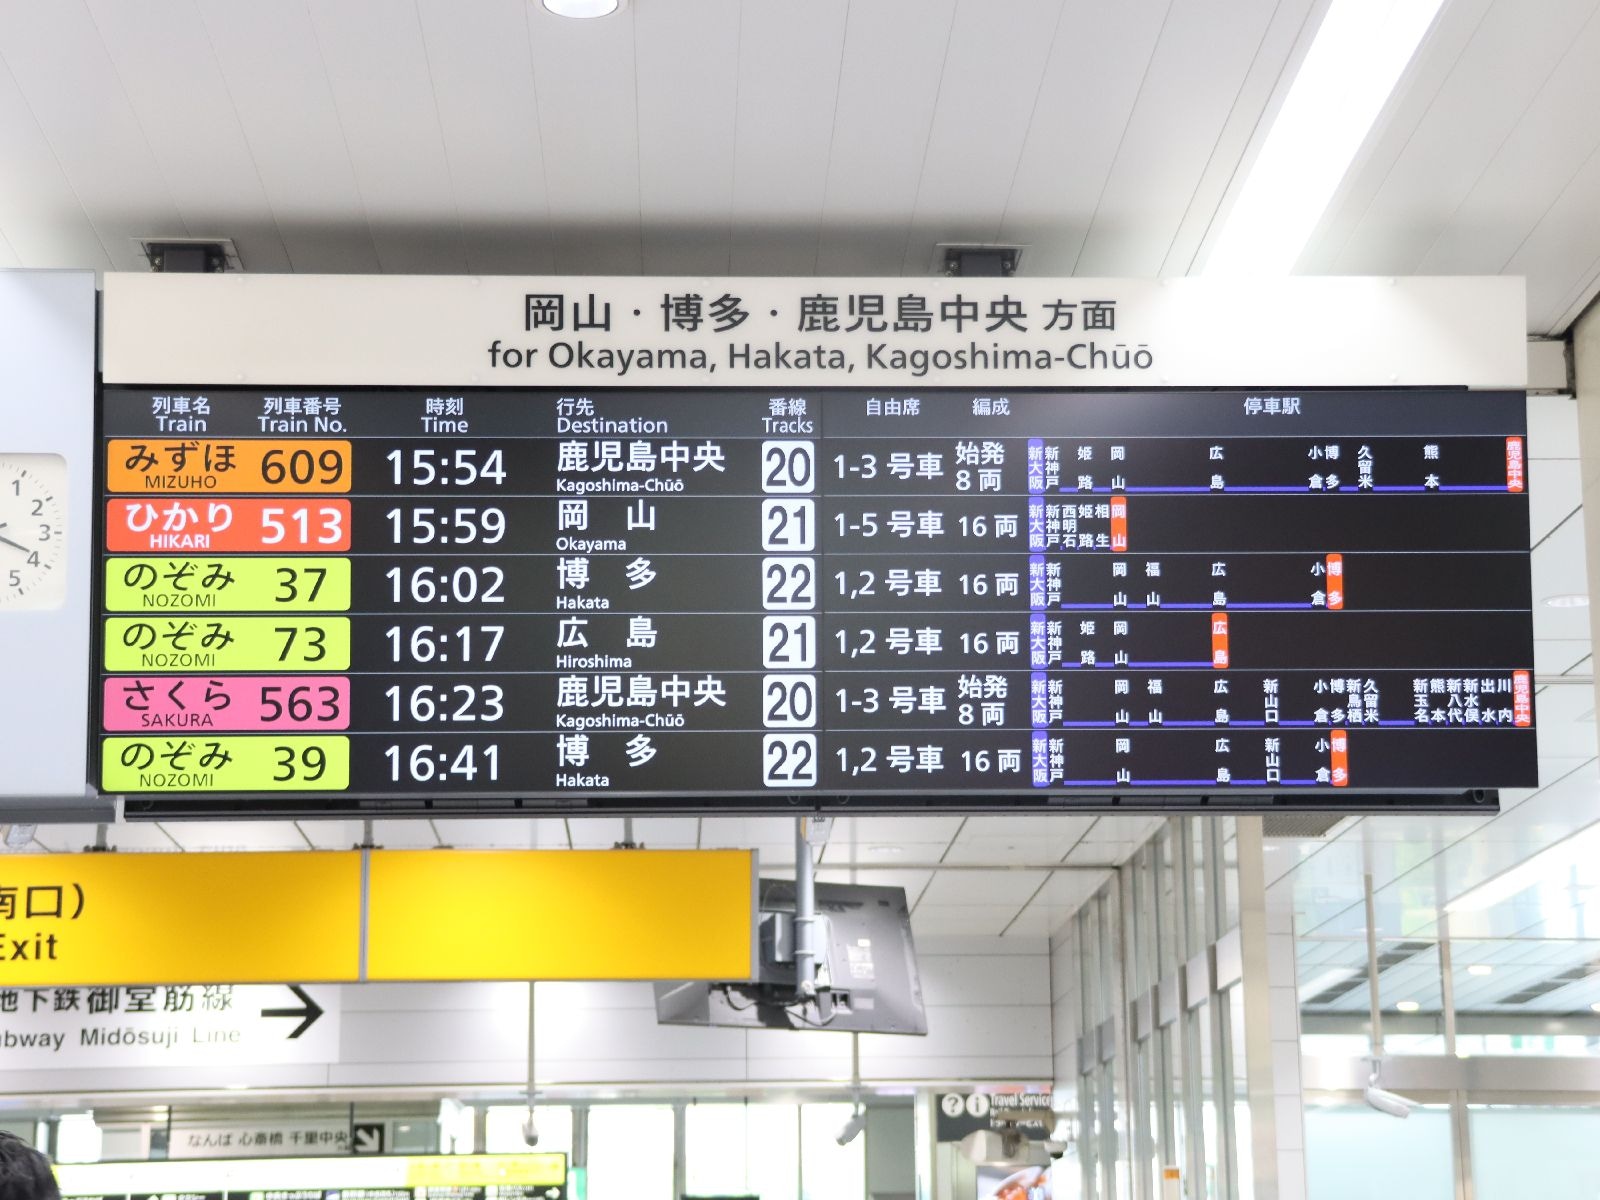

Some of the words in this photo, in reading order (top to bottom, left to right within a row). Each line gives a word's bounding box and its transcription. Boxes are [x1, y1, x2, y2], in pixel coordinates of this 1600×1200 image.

[525, 293, 1028, 334] 岡山・博多・鹿児島中央
[1042, 298, 1117, 332] 方面
[487, 339, 537, 369] for
[548, 340, 717, 377] Okayama,
[729, 341, 855, 374] Hakata,
[867, 341, 1153, 378] Kagoshima-Chūō
[152, 396, 211, 415] 列車名
[156, 415, 207, 432] Train
[257, 415, 311, 433] Train
[315, 415, 347, 433] No.
[263, 396, 342, 415] 列車番号
[420, 415, 469, 433] Time
[425, 397, 464, 415] 時刻
[556, 397, 595, 417] 行先
[768, 397, 807, 417] 番線
[866, 397, 920, 416] 自由席
[971, 397, 1011, 416] 編成
[1243, 396, 1301, 416] 停車駅
[557, 417, 668, 434] Destination
[761, 417, 814, 434] Tracks
[125, 440, 236, 473] みずほ
[261, 449, 343, 485] 609
[386, 449, 507, 486] 15:54
[557, 439, 726, 473] 鹿児島中央
[766, 446, 811, 487] 20
[833, 454, 877, 479] 1-3
[886, 451, 944, 480] 号車
[954, 441, 1005, 466] 始発
[1028, 446, 1044, 490] 新大阪
[1044, 446, 1060, 490] 新神戸
[1077, 446, 1092, 490] 姫路
[1110, 446, 1126, 490] 岡山
[1209, 446, 1224, 489] 広島
[1308, 445, 1323, 489] 小倉
[1324, 445, 1340, 489] 博多
[1358, 445, 1373, 489] 久留米
[1423, 445, 1438, 488] 熊本
[12, 480, 20, 496] 1
[145, 475, 217, 489] MIZUHO
[556, 477, 685, 495] Kagoshima-Chūō
[955, 469, 971, 491] 8
[977, 468, 1002, 492] 両
[31, 499, 43, 516] 2
[125, 501, 233, 533] ひかり
[261, 507, 343, 545] 513
[386, 507, 506, 544] 15:59
[768, 505, 806, 545] 21
[834, 512, 878, 537] 1-5
[886, 509, 945, 539] 号車
[1029, 504, 1044, 548] 新大阪
[1045, 504, 1060, 548] 新神戸
[1062, 504, 1077, 548] 西明石
[1078, 504, 1094, 548] 姫路
[1094, 504, 1110, 548] 相生
[1111, 504, 1126, 548] 岡山
[38, 524, 51, 542] 3
[149, 533, 210, 549] HIKARI
[555, 536, 627, 554] Okayama
[958, 515, 987, 537] 16
[993, 514, 1019, 539] 両
[27, 550, 40, 568] 4
[123, 561, 235, 591] のぞみ
[9, 569, 21, 587] 5
[275, 567, 327, 603] 37
[386, 566, 505, 603] 16:02
[766, 563, 812, 604] 22
[834, 570, 875, 600] 1,2
[884, 568, 943, 597] 号車
[959, 573, 988, 596] 16
[994, 572, 1019, 597] 両
[1030, 562, 1046, 606] 新大阪
[1046, 562, 1062, 606] 新神戸
[1113, 562, 1128, 606] 岡山
[1146, 562, 1162, 606] 福山
[1212, 562, 1227, 606] 広島
[1310, 562, 1326, 606] 小倉
[1328, 562, 1343, 606] 博多
[143, 593, 216, 608] NOZOMI
[556, 594, 610, 610] Hakata
[122, 621, 235, 651] のぞみ
[274, 626, 326, 662] 73
[385, 625, 505, 663] 16:17
[768, 622, 807, 663] 21
[835, 629, 876, 659] 1,2
[885, 626, 943, 656] 号車
[959, 632, 989, 655] 16
[995, 631, 1020, 655] 両
[1031, 620, 1046, 664] 新大阪
[1047, 620, 1062, 664] 新神戸
[1080, 620, 1096, 664] 姫路
[1114, 620, 1129, 664] 岡山
[1212, 620, 1228, 664] 広島
[141, 653, 215, 667] NOZOMI
[556, 653, 632, 669] Hiroshima
[122, 679, 231, 711] さくら
[260, 685, 340, 723] 563
[385, 684, 504, 722] 16:23
[556, 673, 727, 708] 鹿児島中央
[767, 681, 813, 722] 20
[835, 687, 879, 714] 1-3
[888, 685, 947, 715] 号車
[957, 673, 1008, 699] 始発
[1032, 679, 1048, 724] 新大阪
[1048, 679, 1064, 724] 新神戸
[1114, 679, 1130, 724] 岡山
[1148, 679, 1164, 724] 福山
[1214, 679, 1230, 723] 広島
[1264, 679, 1279, 723] 新山口
[1314, 679, 1329, 723] 小倉
[1330, 679, 1346, 723] 博多
[1363, 679, 1378, 723] 久留米
[1413, 679, 1428, 723] 新玉名
[1430, 679, 1446, 723] 熊本
[1446, 679, 1462, 723] 新八代
[1480, 679, 1496, 723] 出水
[1498, 679, 1514, 723] 川内
[141, 713, 214, 727] SAKURA
[556, 712, 685, 731] Kagoshima-Chūō
[958, 703, 974, 726] 8
[980, 702, 1005, 727] 両
[120, 740, 233, 771] のぞみ
[273, 745, 327, 782] 39
[384, 744, 498, 782] 16:41
[767, 740, 813, 781] 22
[836, 746, 877, 777] 1,2
[885, 744, 945, 774] 号車
[961, 749, 989, 772] 16
[997, 749, 1022, 773] 両
[1032, 738, 1048, 783] 新大阪
[1049, 738, 1064, 783] 新神戸
[1116, 738, 1131, 783] 岡山
[1216, 738, 1231, 783] 広島
[1265, 738, 1280, 783] 新山口
[1315, 738, 1330, 783] 小倉
[1332, 738, 1348, 783] 博多
[139, 773, 214, 787] NOZOMI
[556, 772, 610, 787] Hakata
[0, 1030, 66, 1052] bway
[80, 1026, 178, 1049] Midōsuji
[193, 1027, 241, 1043] Line
[188, 1132, 232, 1148] なんば
